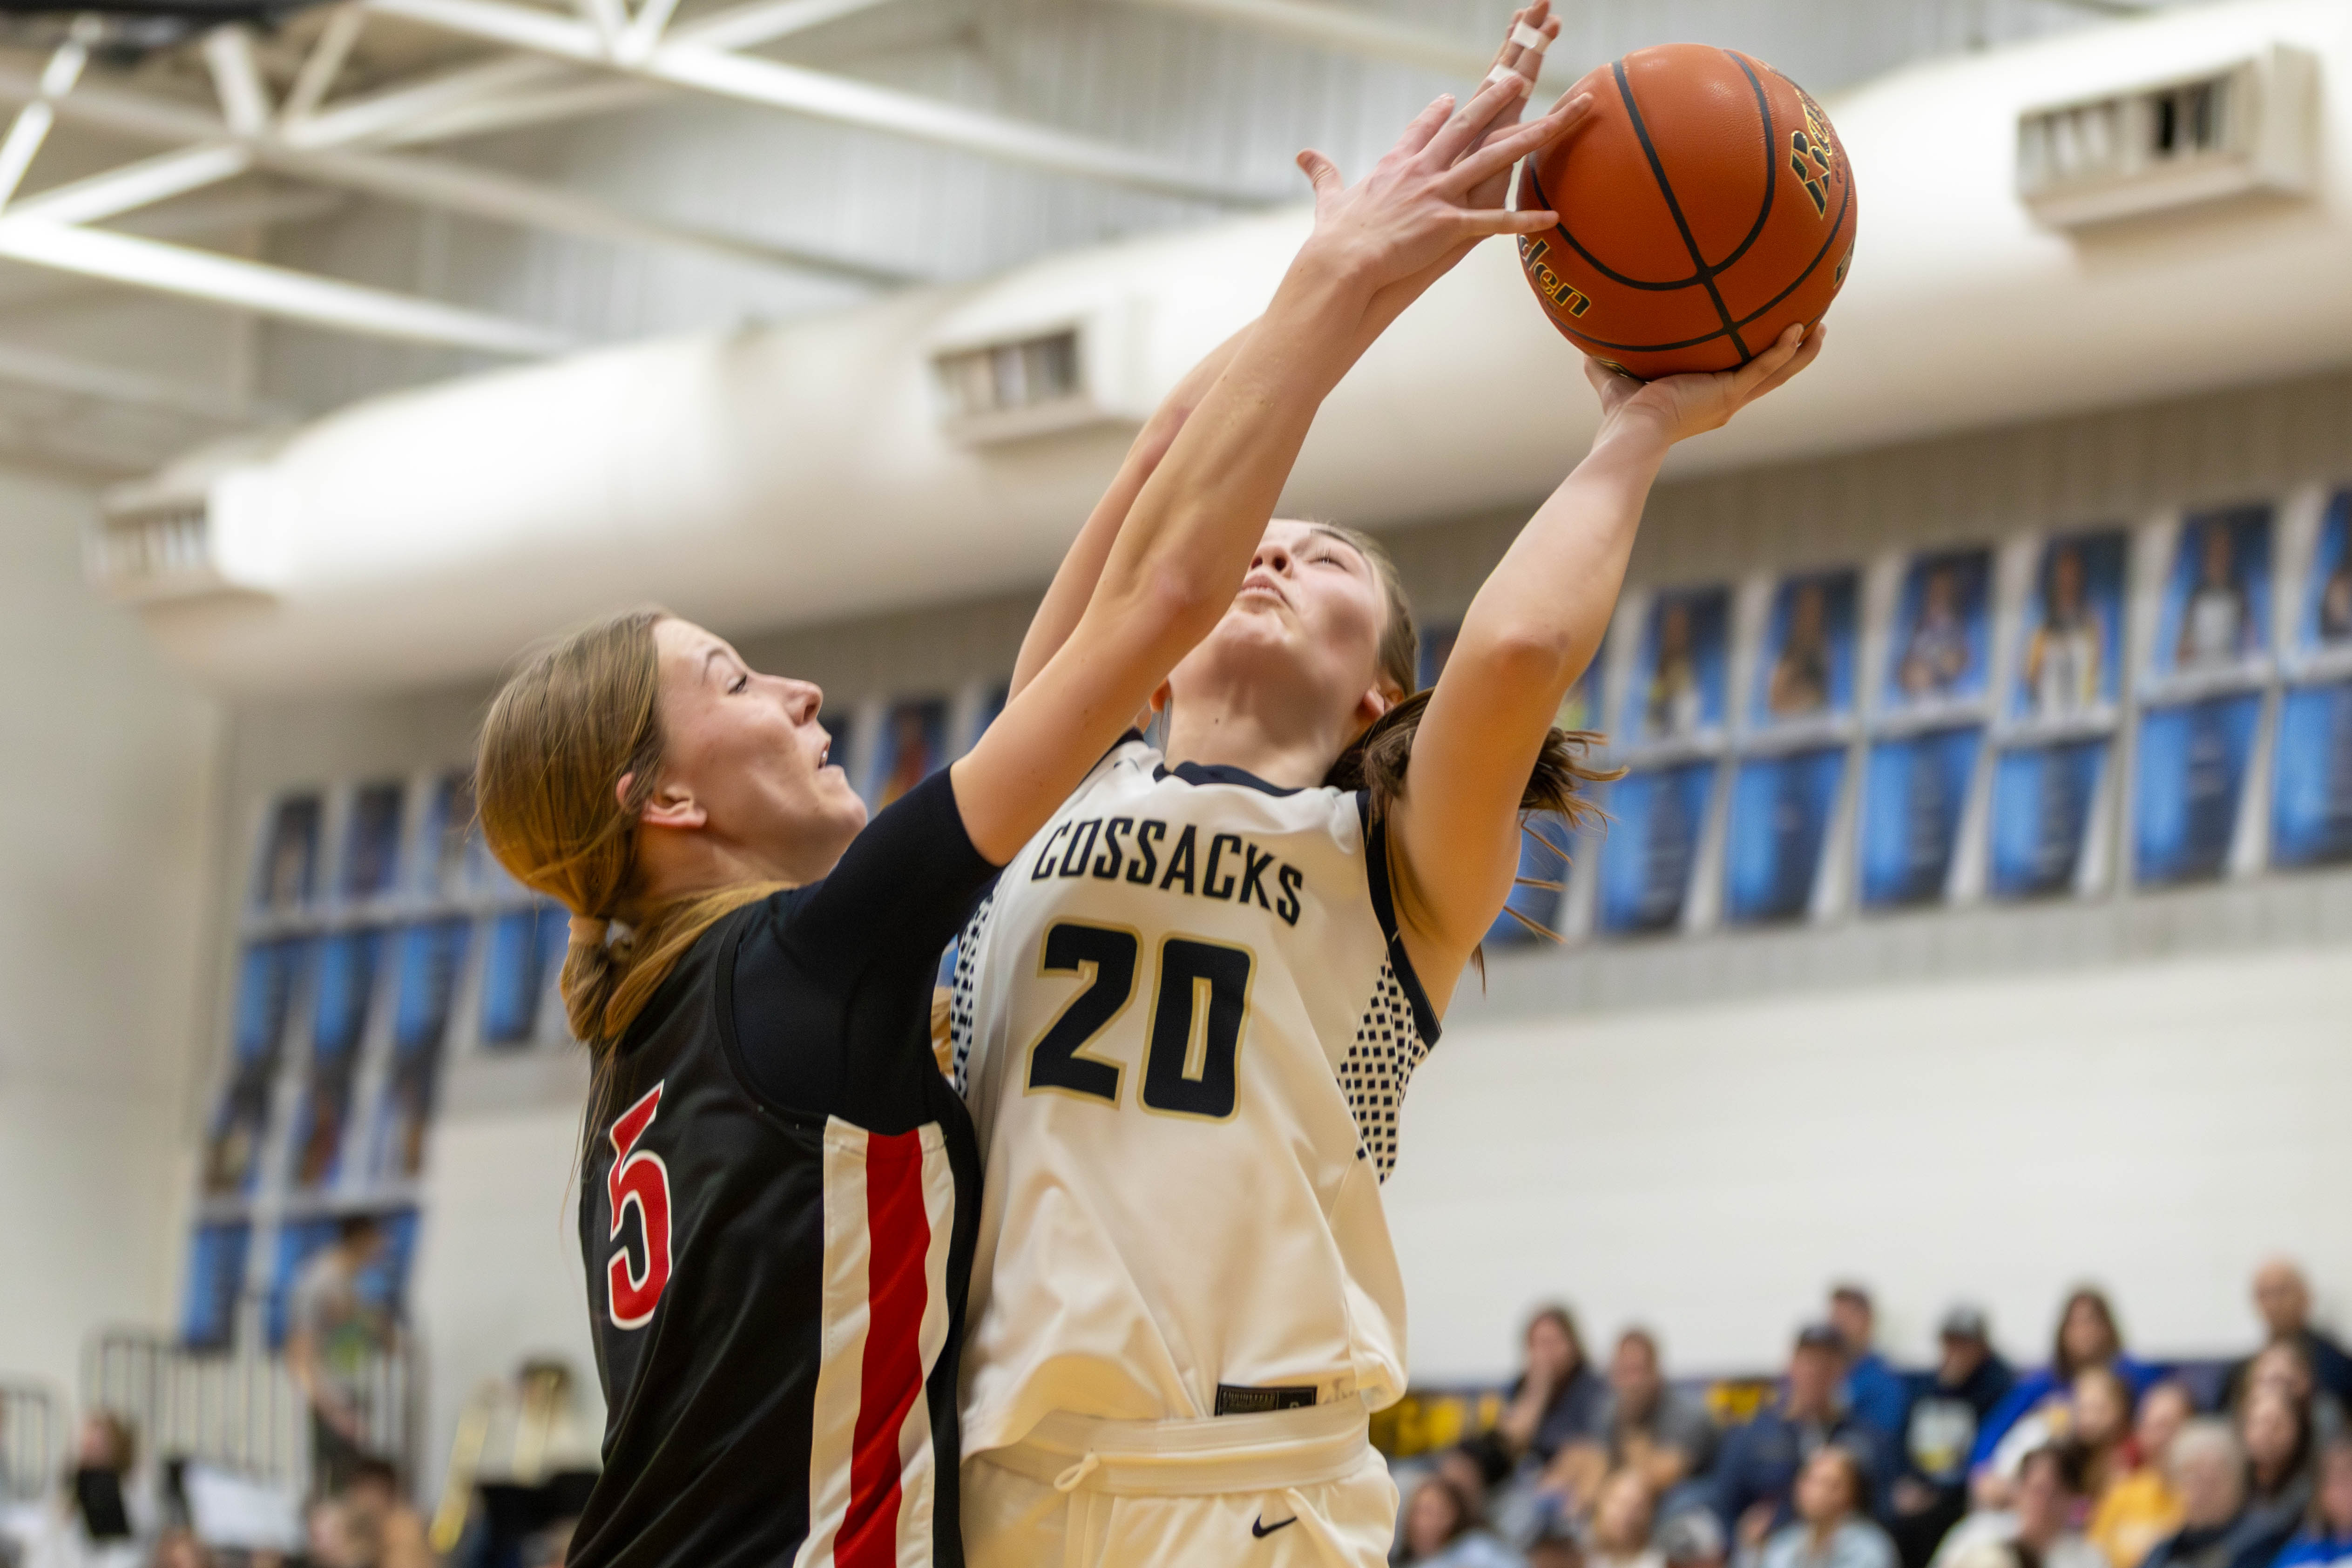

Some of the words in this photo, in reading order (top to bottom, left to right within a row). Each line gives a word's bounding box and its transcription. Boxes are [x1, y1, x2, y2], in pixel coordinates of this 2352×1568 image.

[1031, 817, 1303, 926] COSSACKS
[1023, 915, 1257, 1126] 20
[608, 1079, 672, 1331] 5
